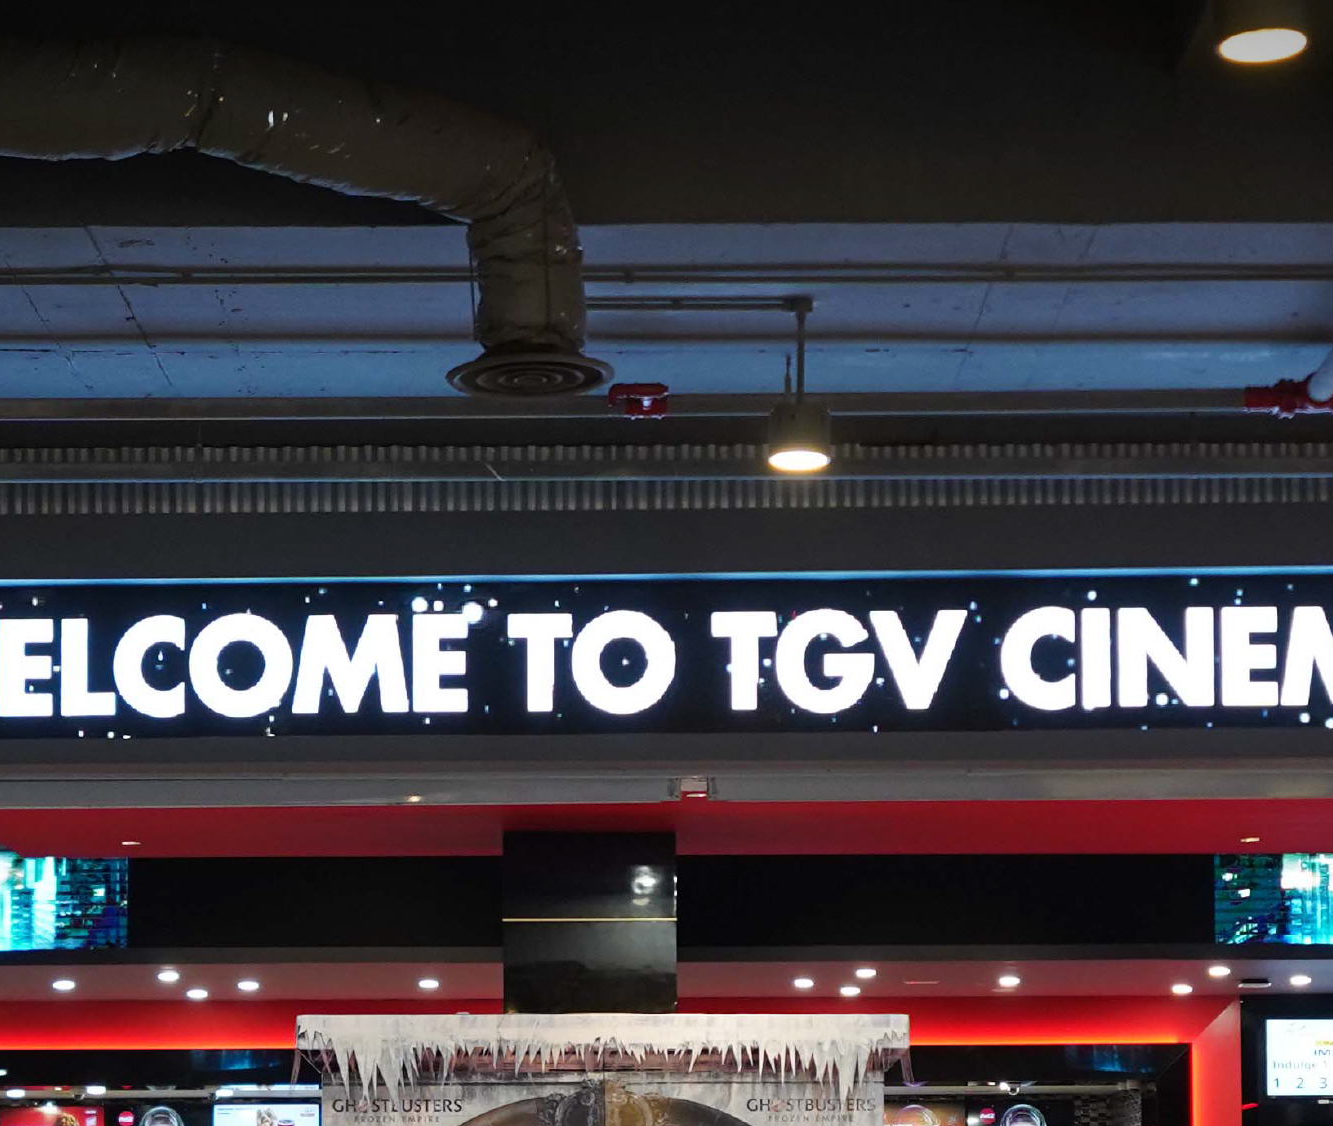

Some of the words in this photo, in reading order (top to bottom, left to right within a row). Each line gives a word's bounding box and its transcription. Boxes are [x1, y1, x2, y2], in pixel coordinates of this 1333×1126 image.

[507, 609, 676, 716] TO
[710, 608, 968, 714] TGV
[1274, 1078, 1280, 1089] 1
[1296, 1078, 1305, 1089] 2
[1319, 1078, 1328, 1089] 3
[354, 1115, 396, 1123] FROZEN
[402, 1115, 440, 1123] EMPIRE
